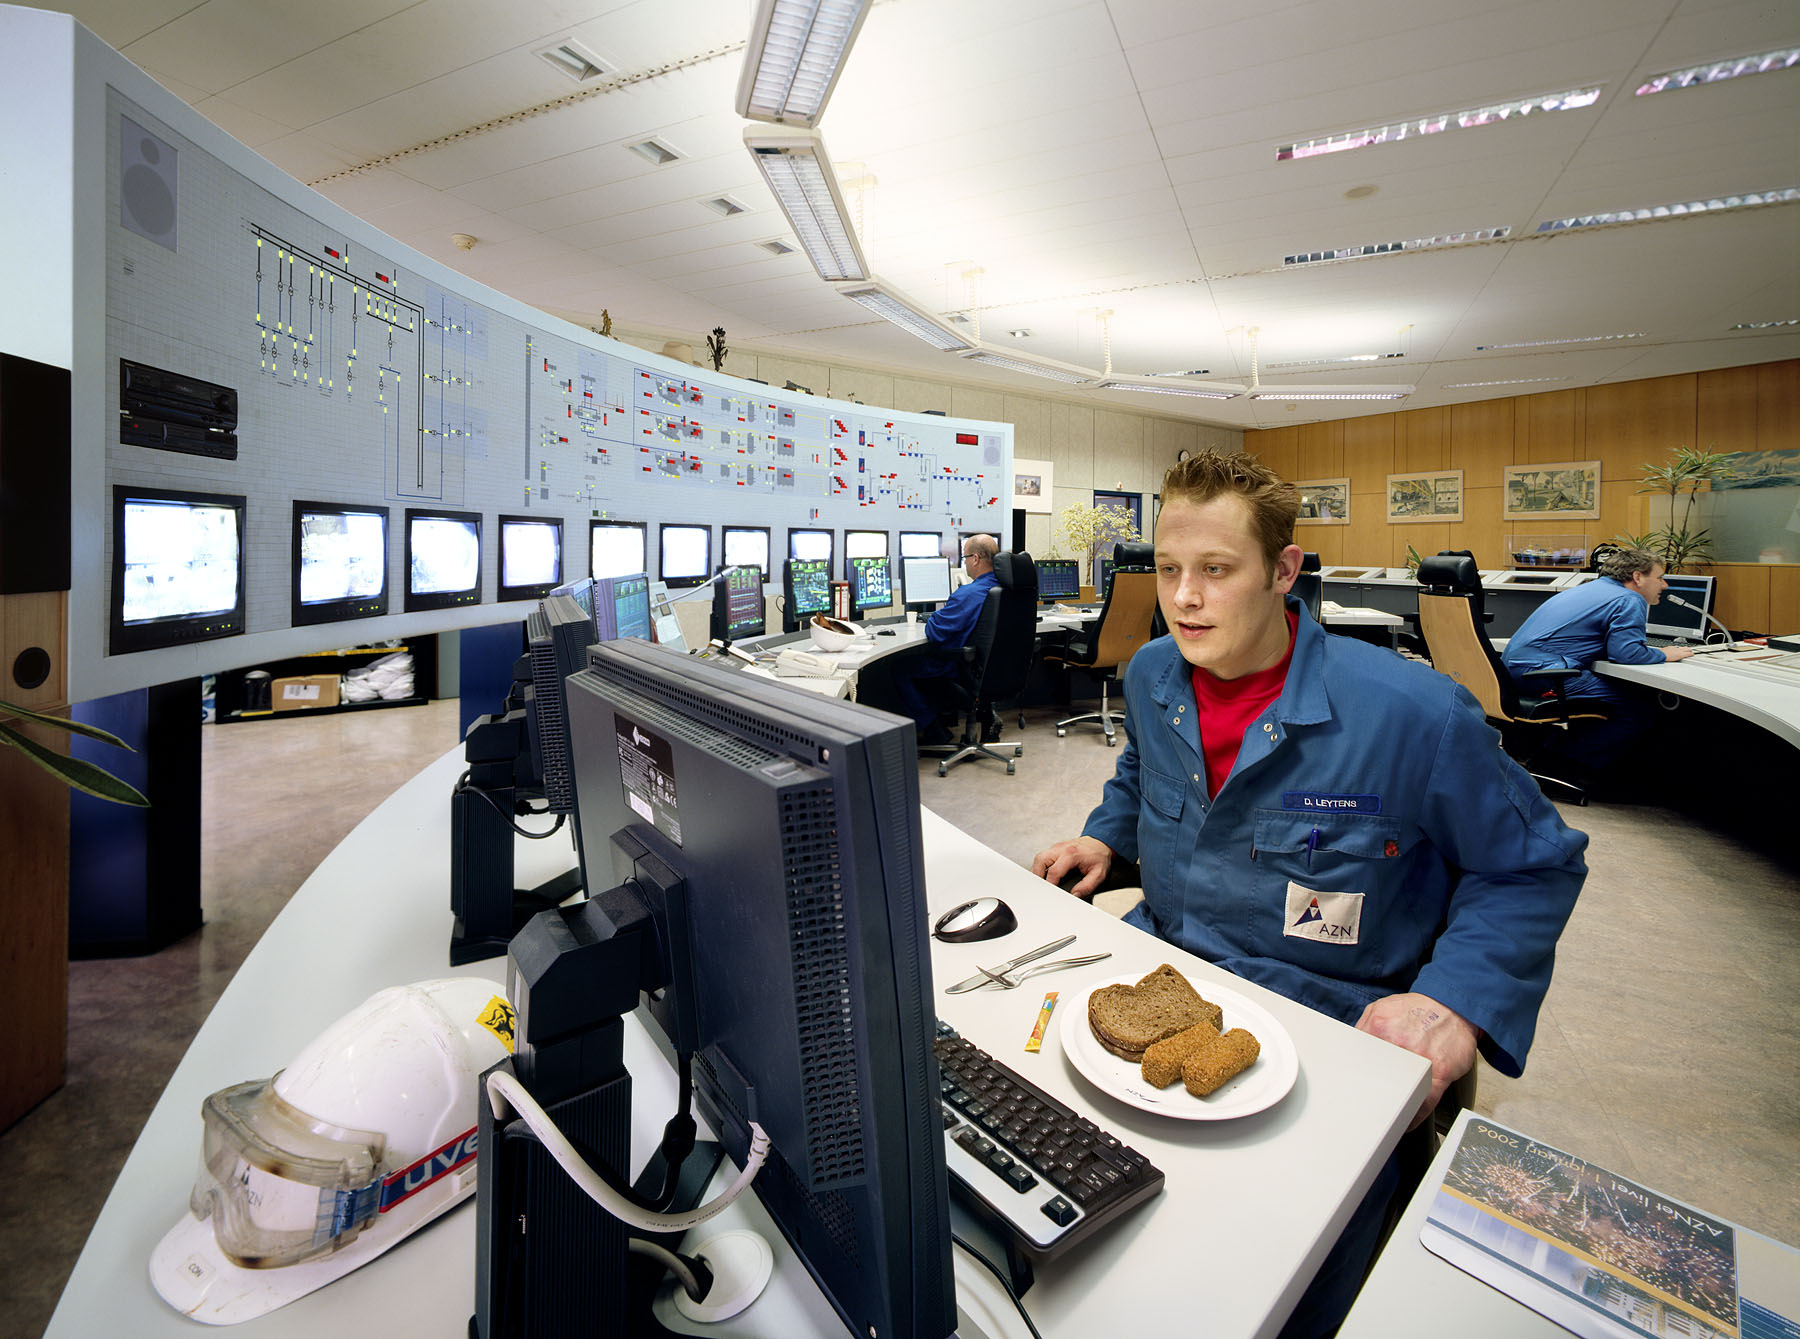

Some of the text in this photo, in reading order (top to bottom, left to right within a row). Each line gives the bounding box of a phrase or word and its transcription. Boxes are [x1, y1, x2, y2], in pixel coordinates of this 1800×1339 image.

[1304, 797, 1357, 808] D. LEYTENS
[1319, 923, 1352, 937] AZN
[1477, 1125, 1520, 1149] 2006
[404, 1131, 479, 1191] uve
[1655, 1202, 1724, 1237] AZNet
